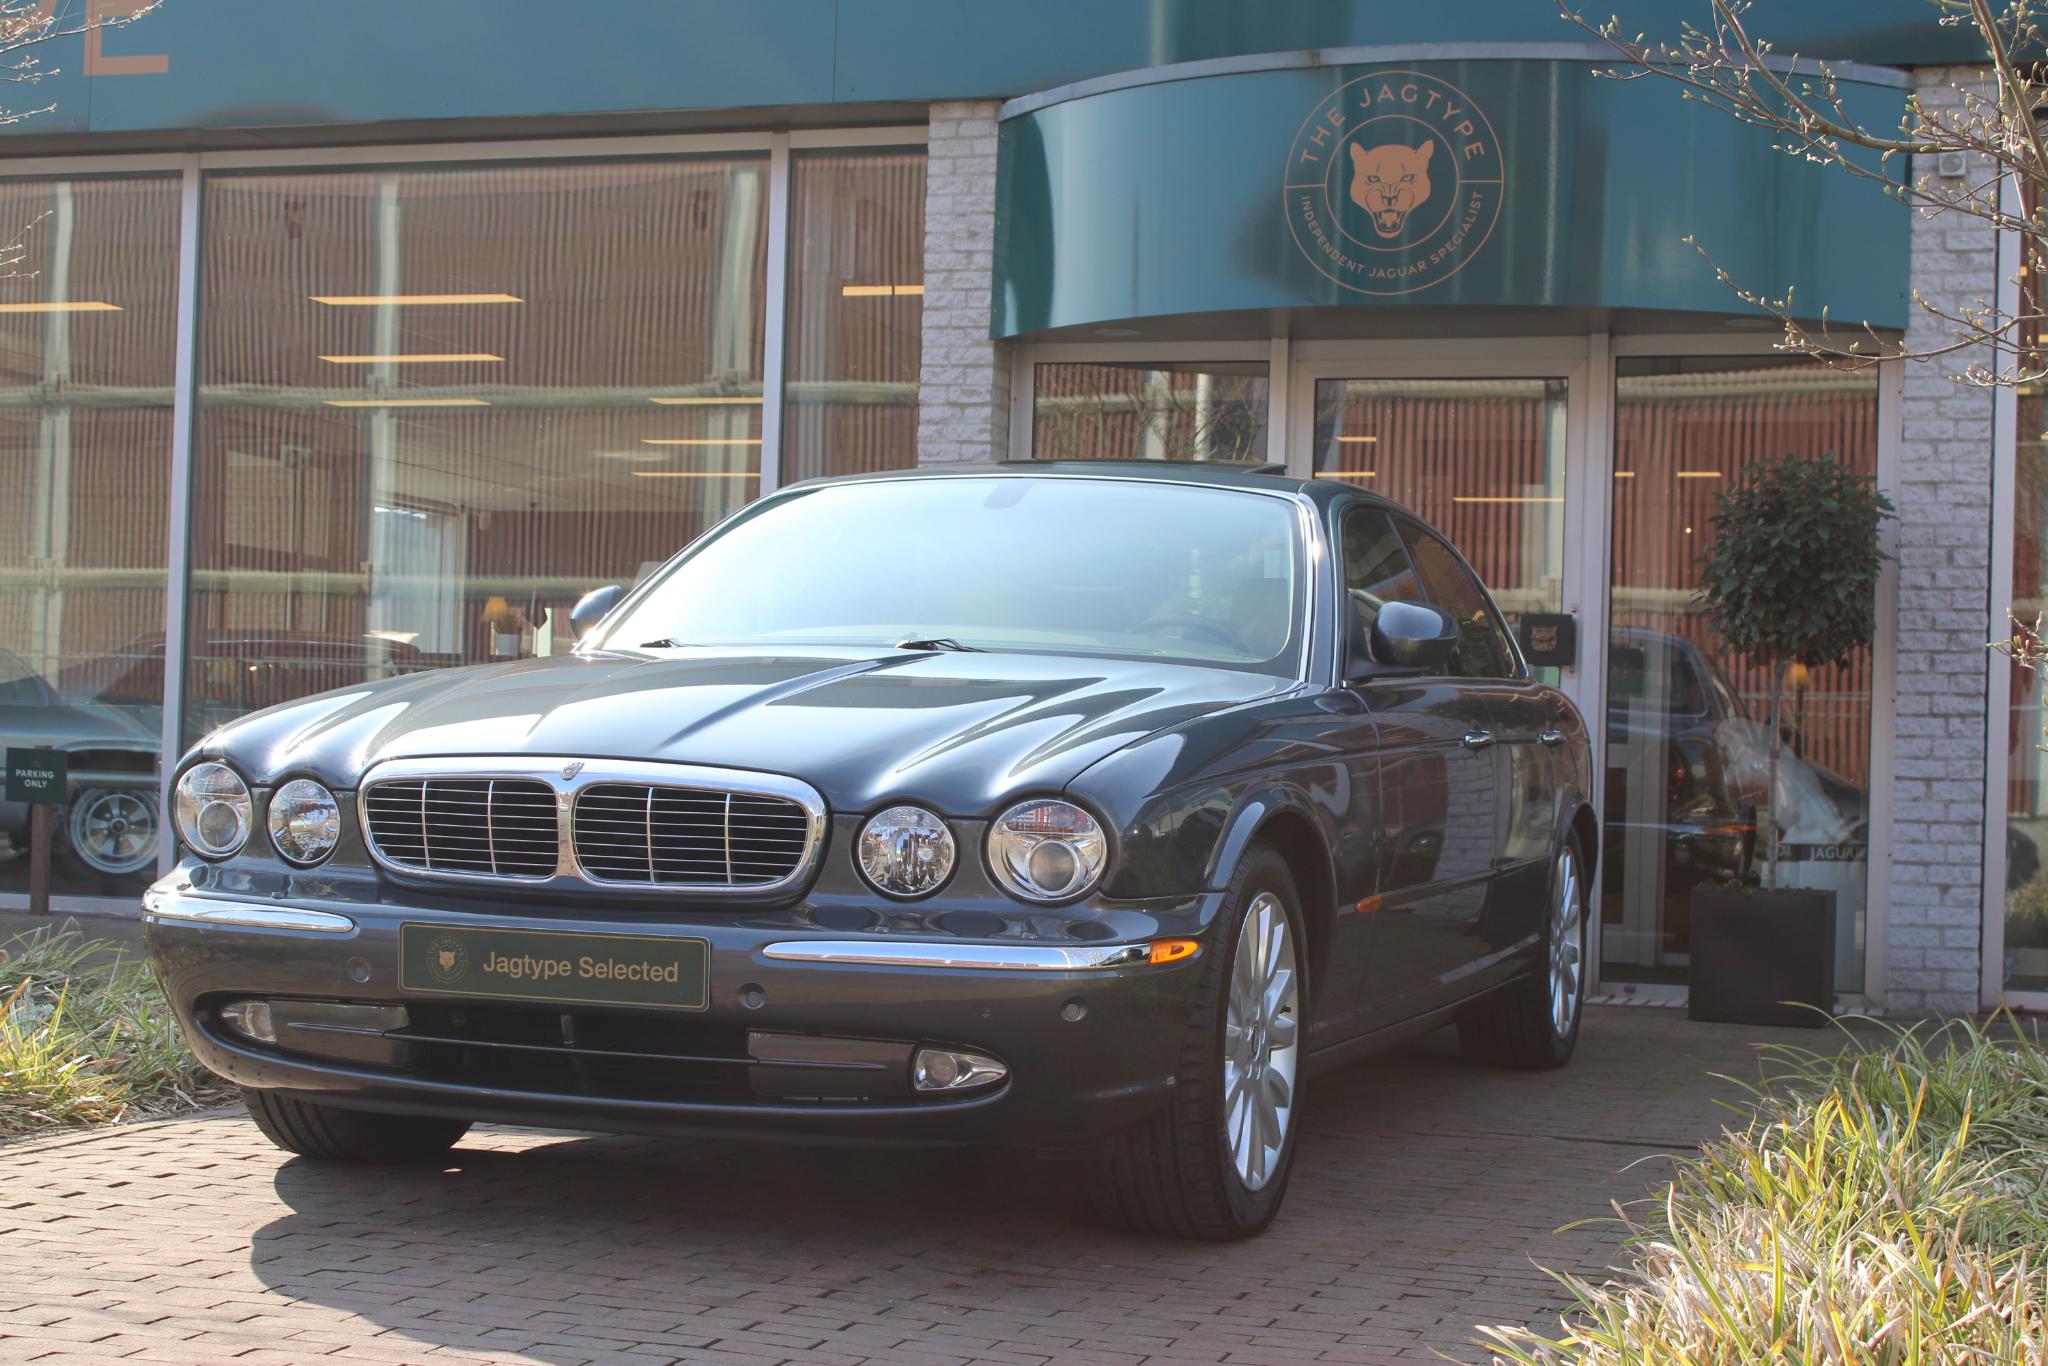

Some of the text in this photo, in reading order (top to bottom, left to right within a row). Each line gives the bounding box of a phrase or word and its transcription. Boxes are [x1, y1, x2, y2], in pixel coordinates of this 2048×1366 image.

[1300, 83, 1485, 163] THE JAGTYPE
[1301, 191, 1483, 279] INDEPENDENT JAGUAR SPECIALIST
[15, 769, 54, 779] PARKING
[24, 779, 48, 788] ONLY
[483, 951, 571, 980] Jagtype
[578, 957, 678, 983] Selected
